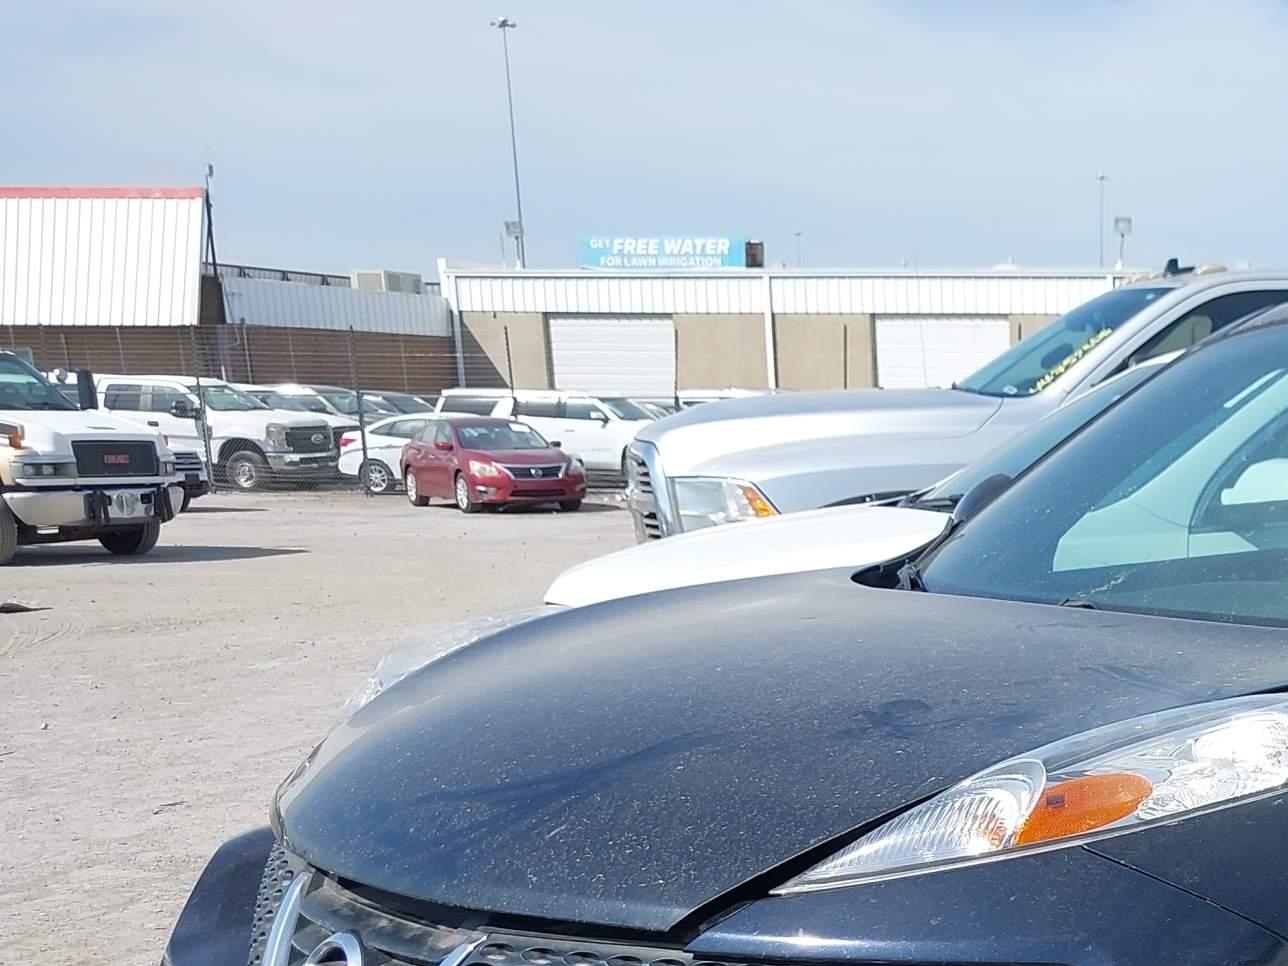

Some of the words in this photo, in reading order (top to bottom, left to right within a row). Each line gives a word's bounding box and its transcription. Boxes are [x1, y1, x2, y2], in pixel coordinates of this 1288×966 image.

[590, 239, 610, 249] GET
[612, 238, 660, 255] FREE
[663, 238, 730, 255] WATER
[600, 256, 622, 267] FOR
[624, 256, 657, 267] LAWN
[658, 256, 722, 267] IRRIGATION
